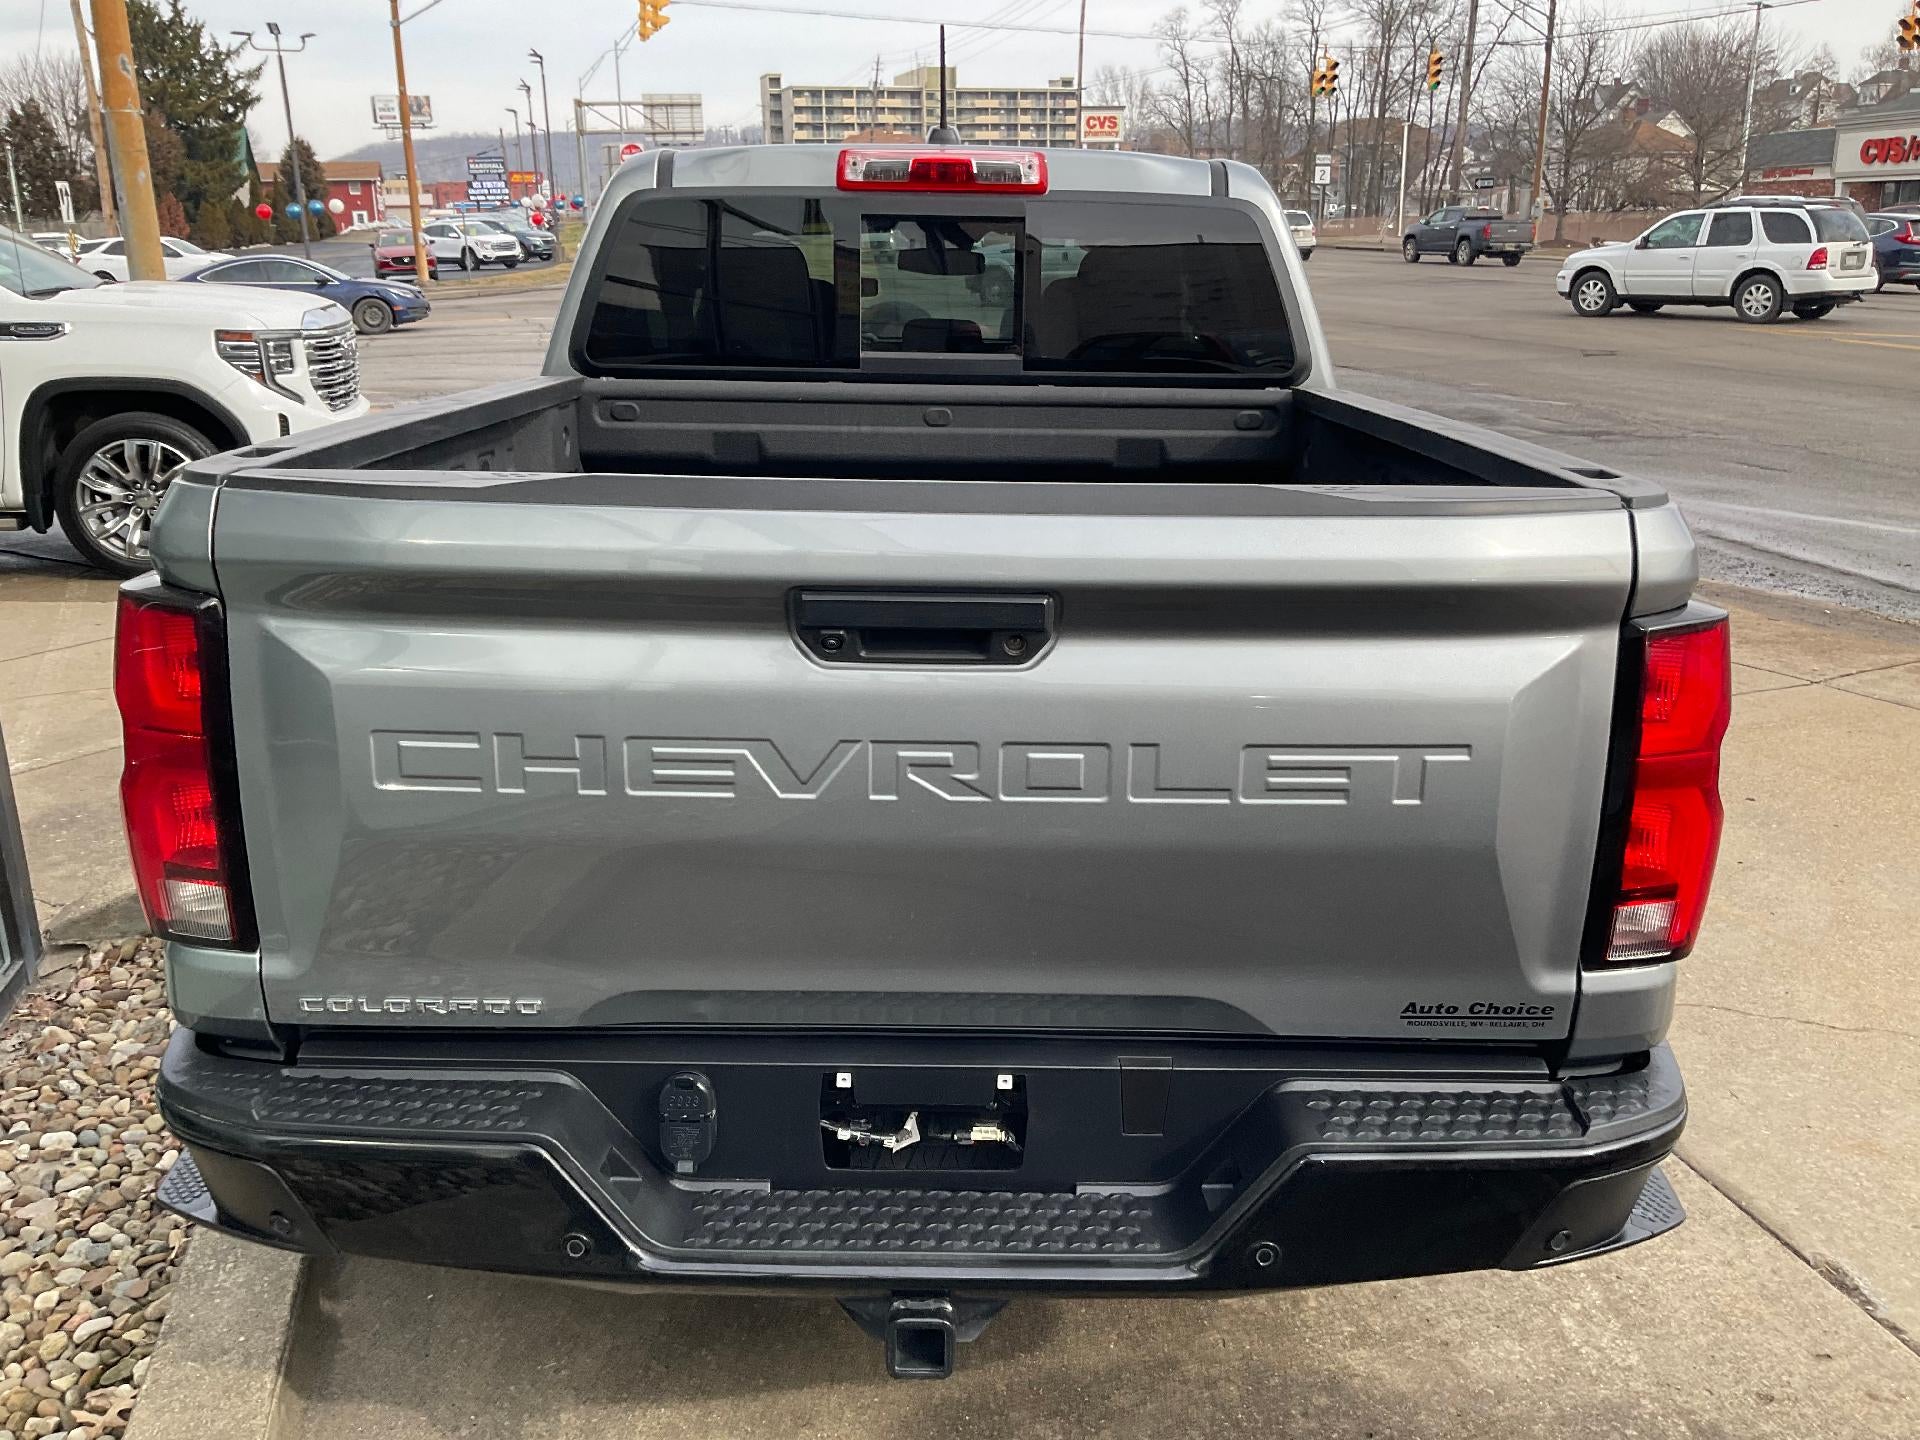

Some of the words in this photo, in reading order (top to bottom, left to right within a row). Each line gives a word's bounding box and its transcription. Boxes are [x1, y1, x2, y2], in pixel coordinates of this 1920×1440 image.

[1086, 115, 1117, 129] CVS
[1319, 169, 1326, 181] 2
[370, 729, 1472, 806] CHEVROLET
[299, 997, 544, 1015] COLORADO
[1401, 1002, 1459, 1015] Auto
[1468, 1002, 1555, 1016] Choice
